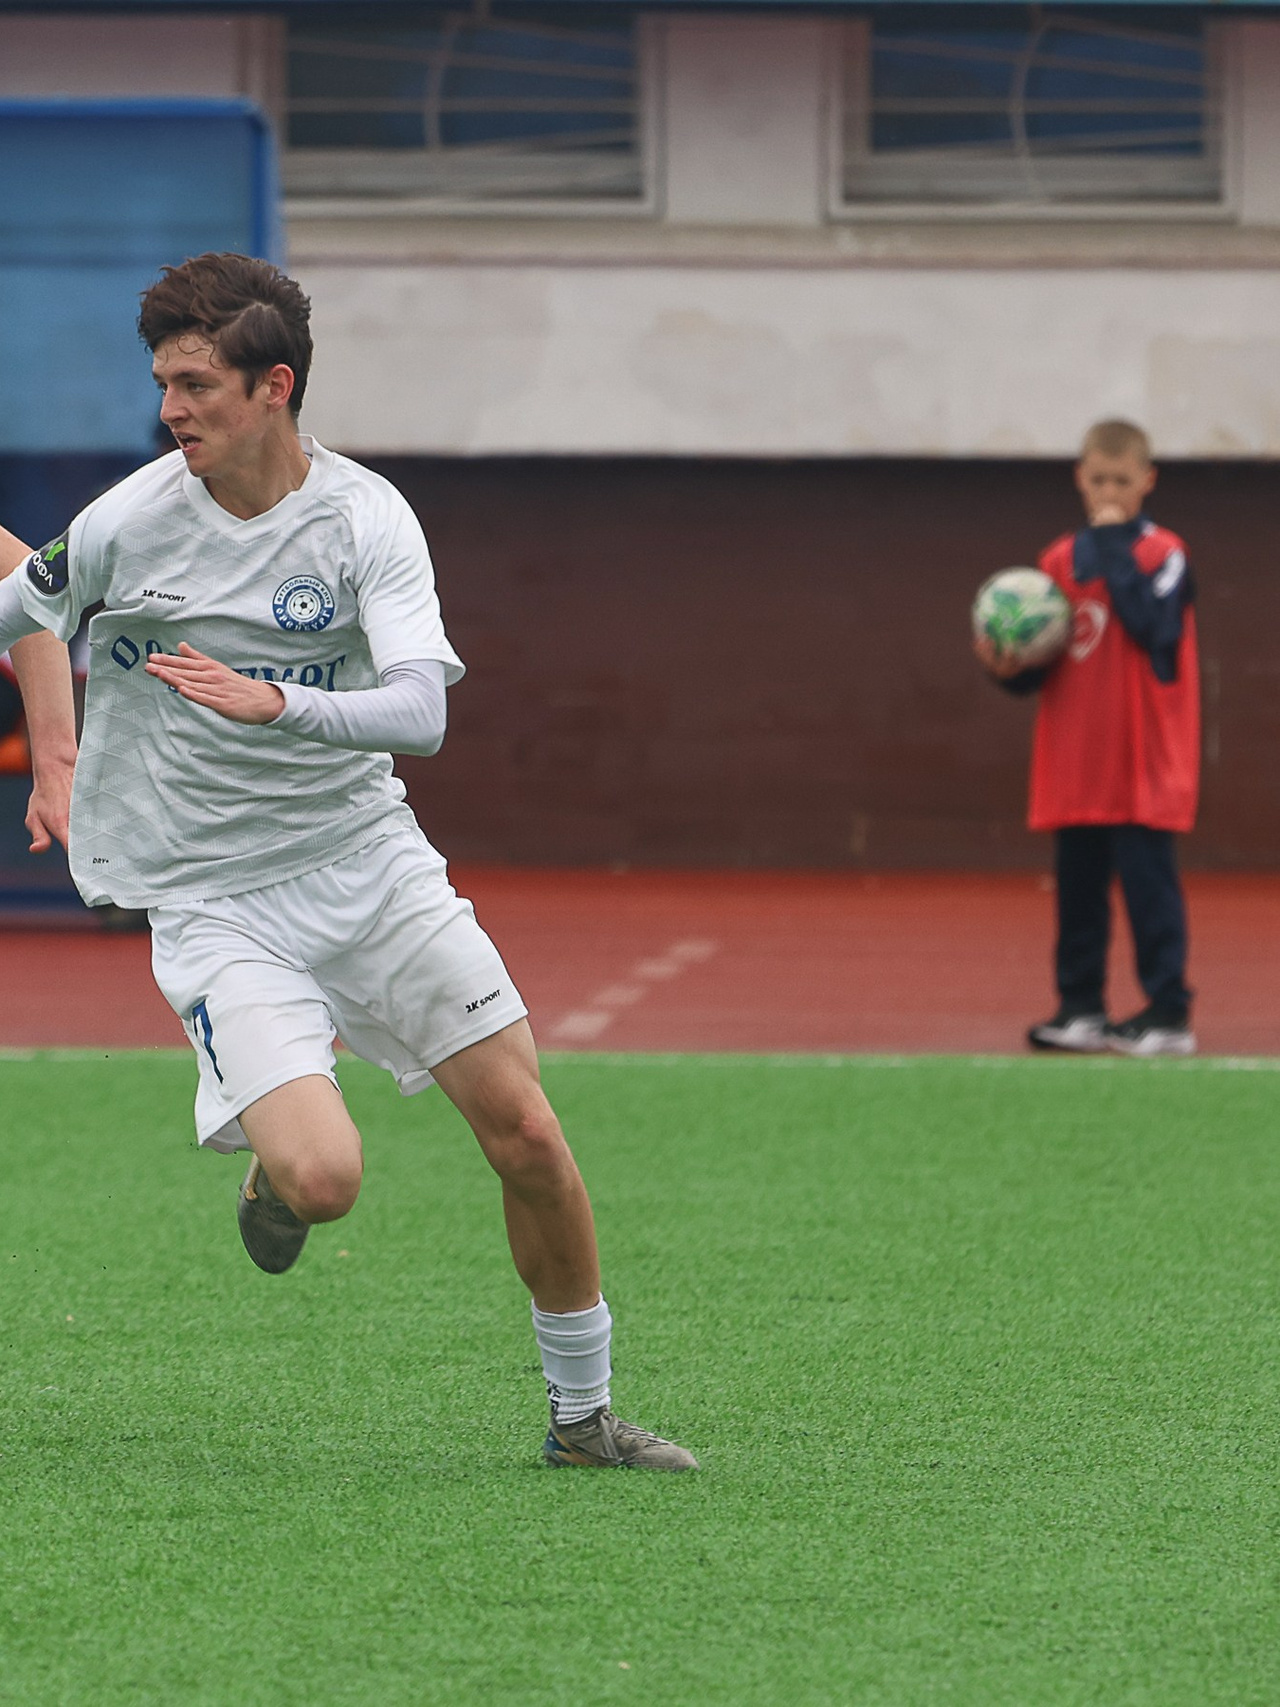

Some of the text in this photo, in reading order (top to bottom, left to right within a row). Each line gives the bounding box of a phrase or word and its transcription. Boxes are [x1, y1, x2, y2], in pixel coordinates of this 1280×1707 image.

[157, 593, 187, 603] SPORT
[465, 989, 501, 1014] 2K SPORT
[192, 998, 224, 1085] 7
